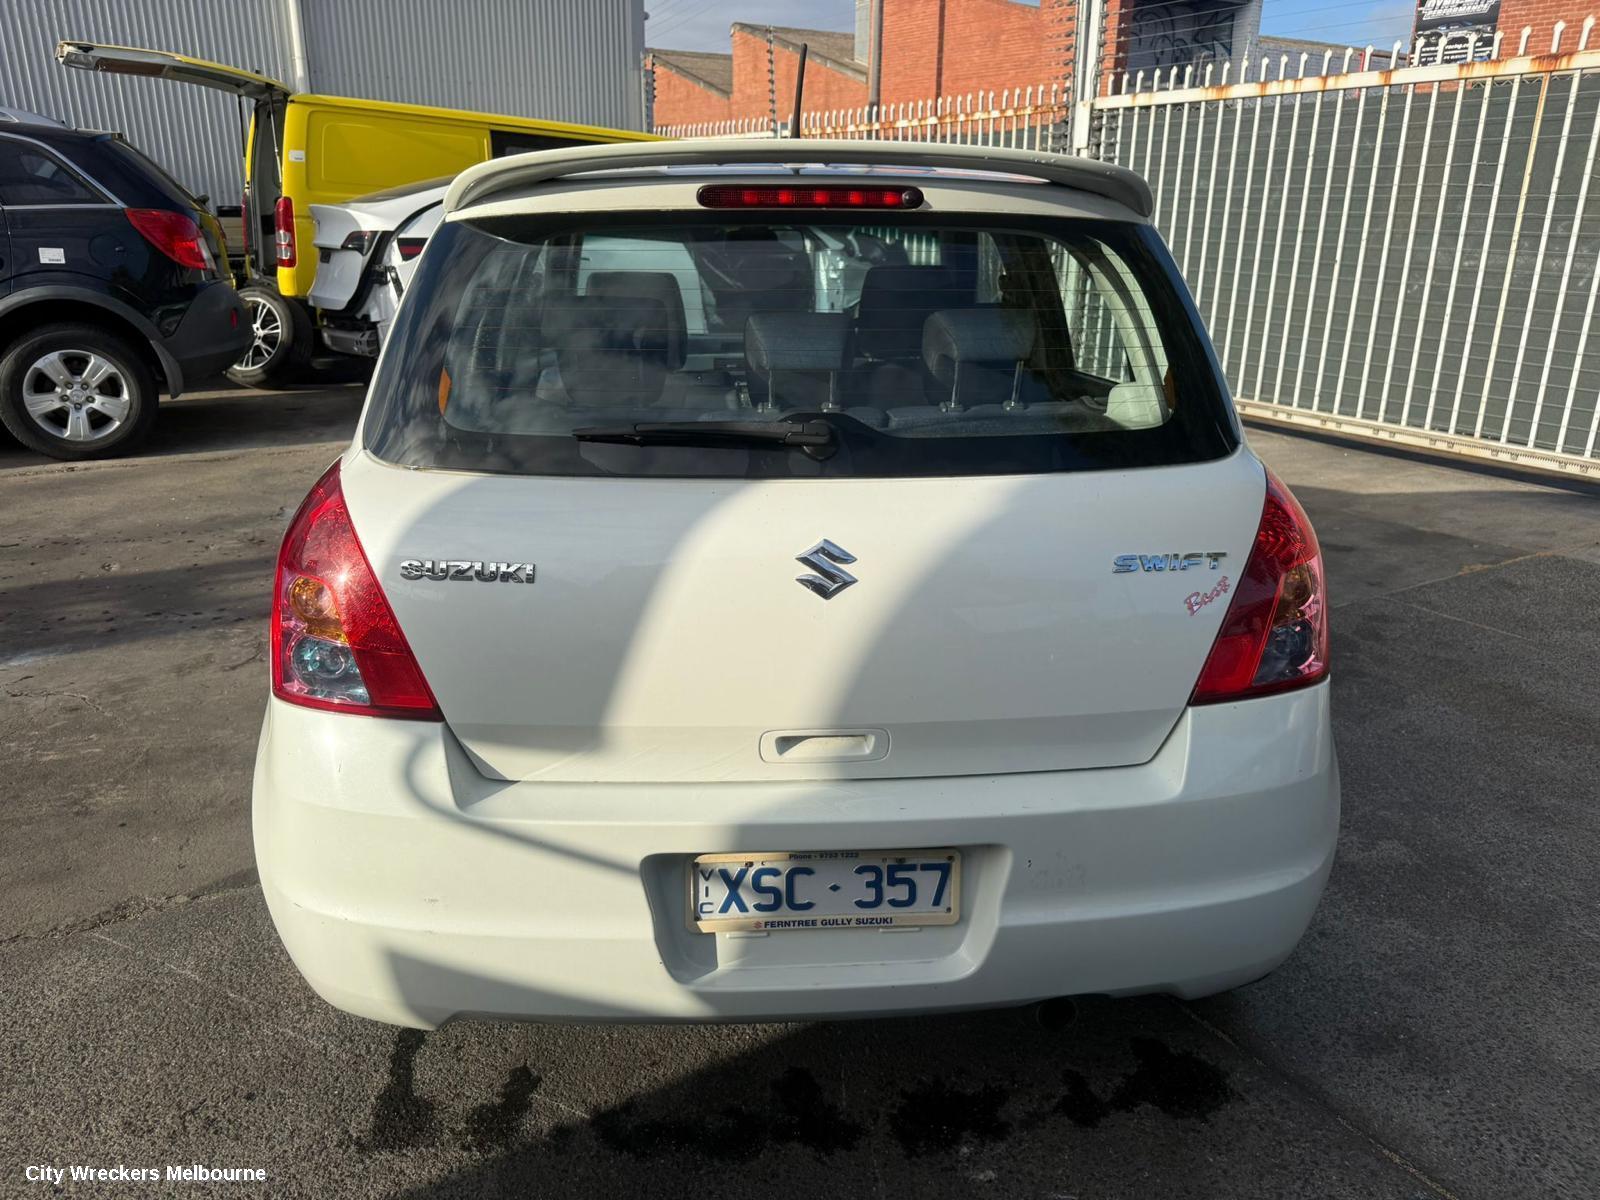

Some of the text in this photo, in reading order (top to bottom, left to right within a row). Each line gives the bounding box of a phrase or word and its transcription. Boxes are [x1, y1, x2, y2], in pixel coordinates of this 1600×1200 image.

[400, 559, 536, 584] SUZUKI
[1112, 552, 1228, 573] SWIFT
[699, 868, 714, 914] VIC
[718, 863, 951, 914] XSC 357
[764, 917, 893, 928] FERNTREE GULLY SUZUKI
